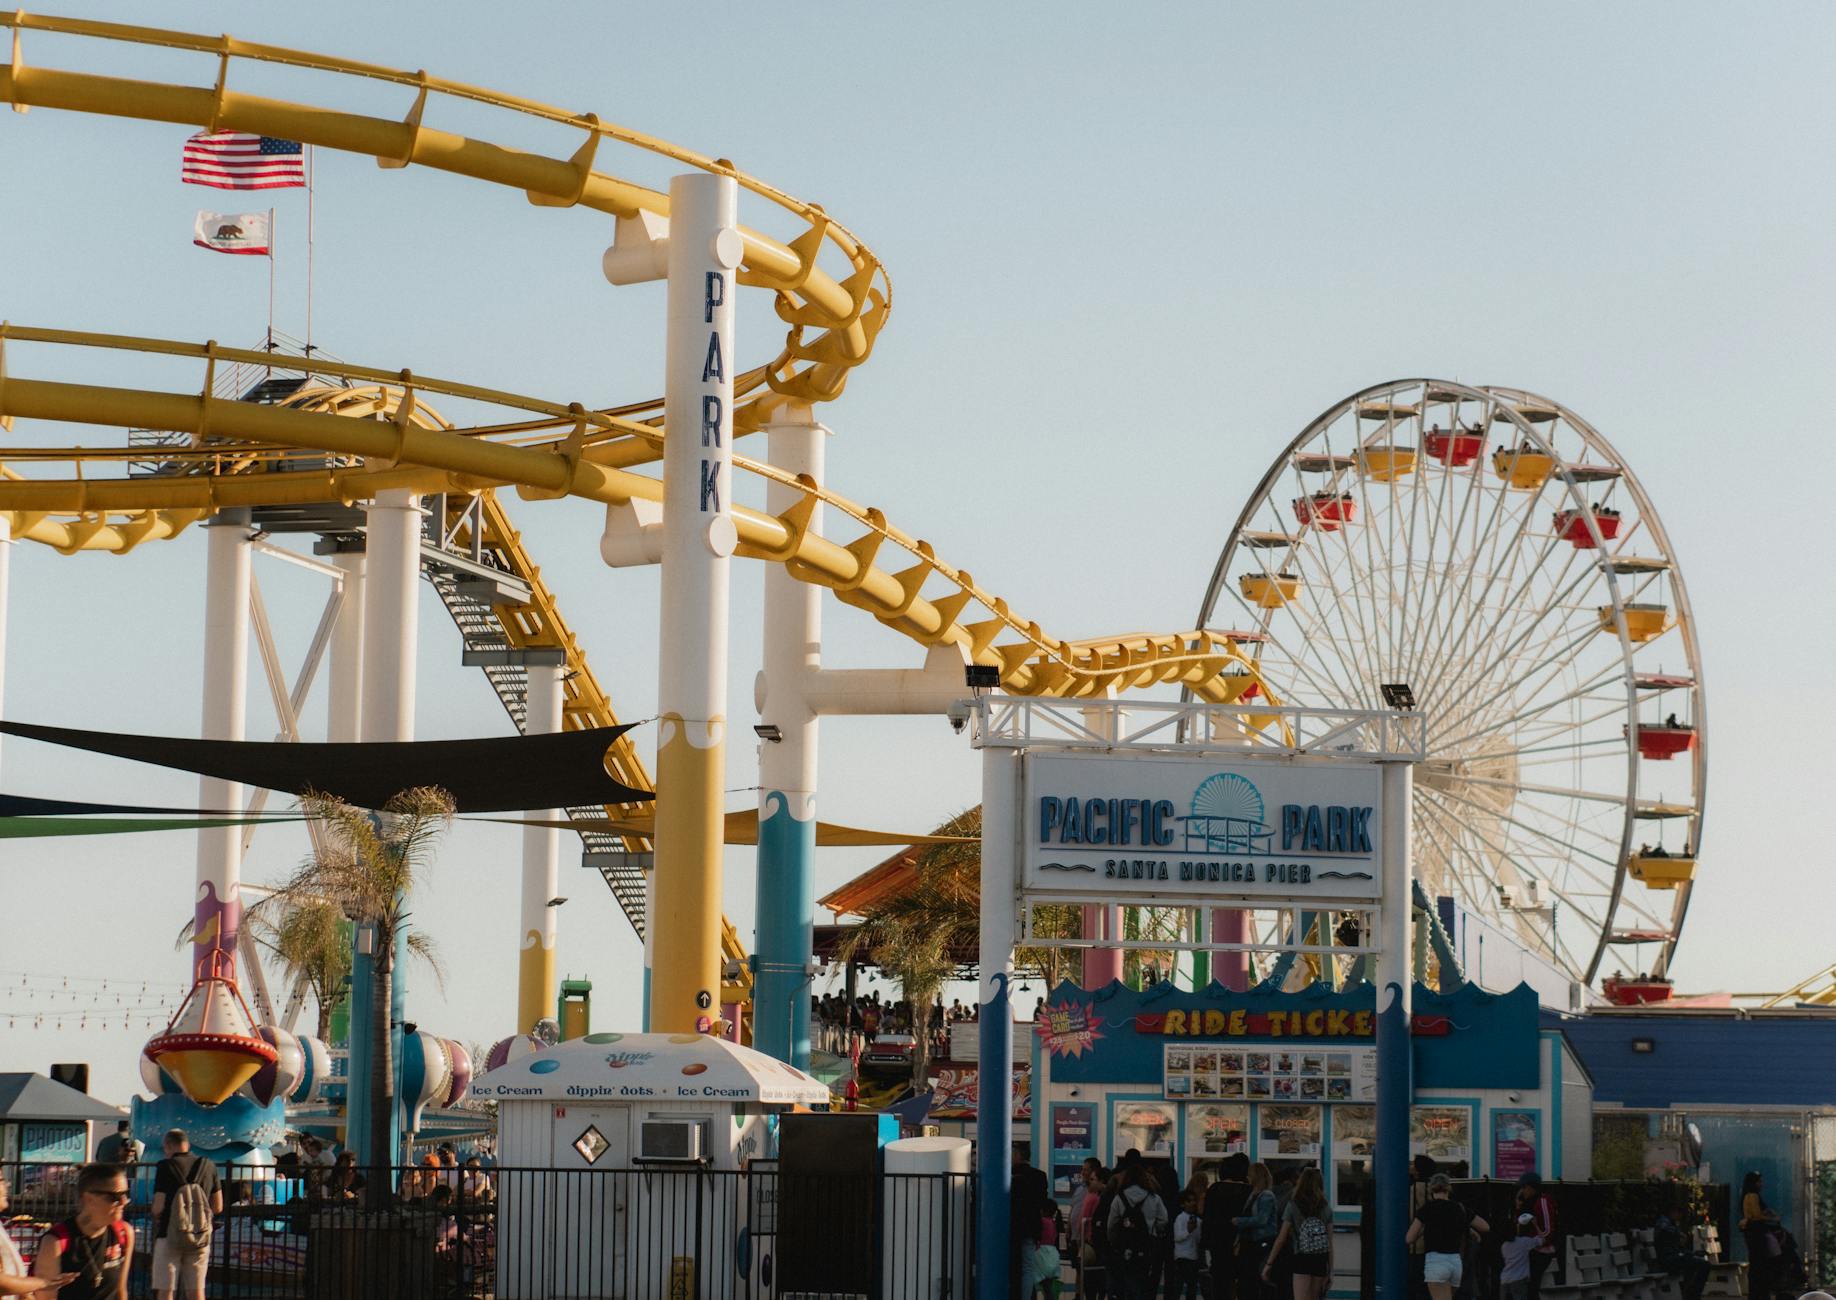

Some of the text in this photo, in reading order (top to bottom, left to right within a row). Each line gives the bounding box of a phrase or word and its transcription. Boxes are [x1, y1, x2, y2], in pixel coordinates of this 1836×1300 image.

[700, 271, 725, 513] PARK
[1040, 796, 1373, 852] PACIFIC PARK
[1105, 859, 1312, 883] SANTA MONICA PIER
[1163, 1008, 1372, 1037] RIDE TICKE
[472, 1085, 492, 1096] Ice
[496, 1085, 543, 1096] Cream
[677, 1085, 698, 1097] Ice
[703, 1085, 750, 1097] Cream
[1274, 1119, 1311, 1130] CLOSED
[1423, 1118, 1458, 1130] OPEN
[26, 1127, 83, 1152] PHOTOS
